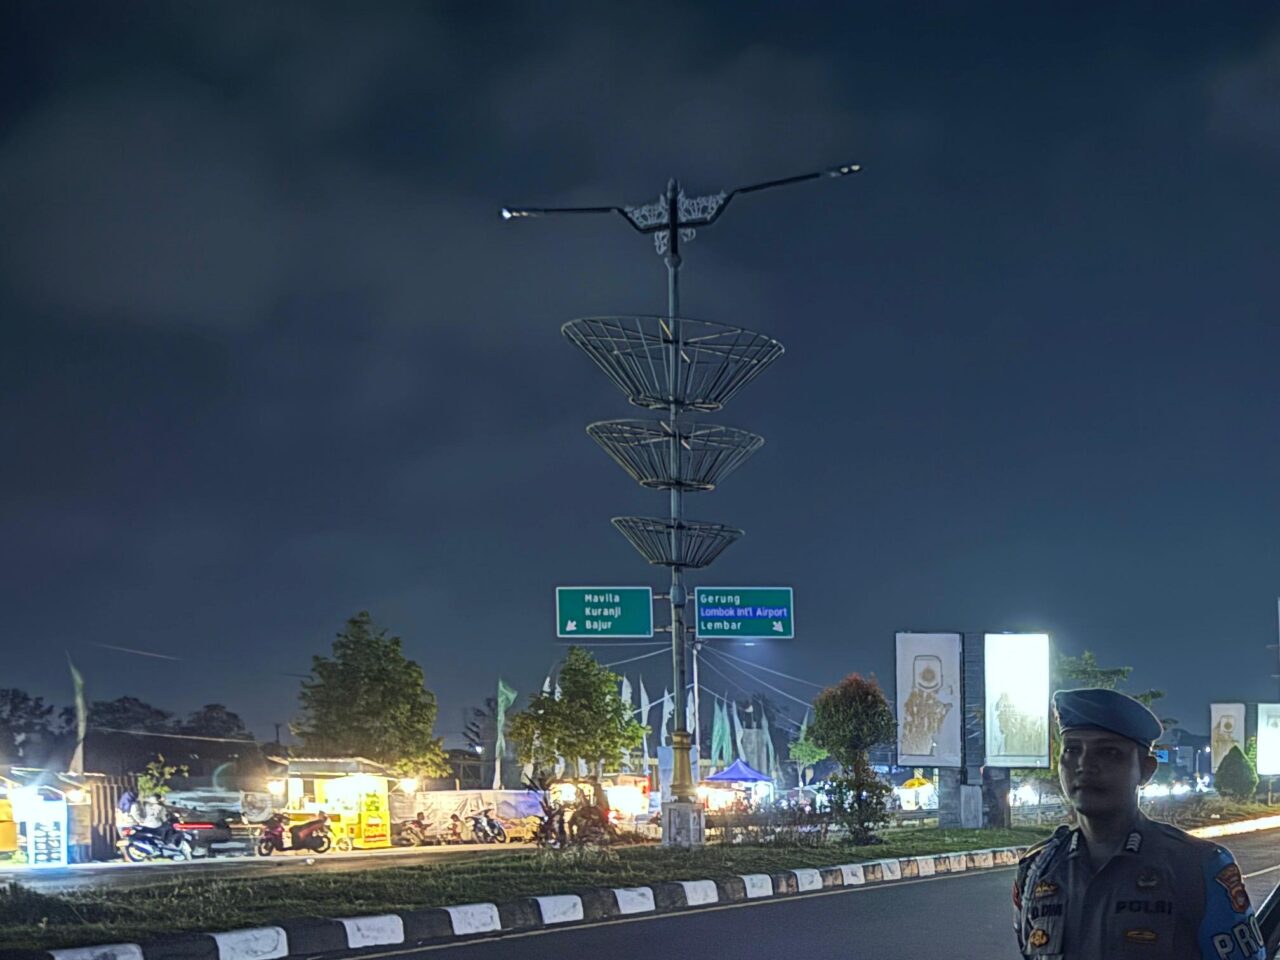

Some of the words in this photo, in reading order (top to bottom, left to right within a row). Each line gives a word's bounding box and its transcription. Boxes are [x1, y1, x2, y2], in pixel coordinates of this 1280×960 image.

[700, 593, 741, 606] Gerung
[584, 606, 622, 618] Kuranji
[700, 606, 735, 617] Lombok
[756, 607, 787, 619] Airport
[585, 620, 612, 631] Bajur
[700, 620, 741, 630] Lembar
[1115, 900, 1173, 915] POLRI
